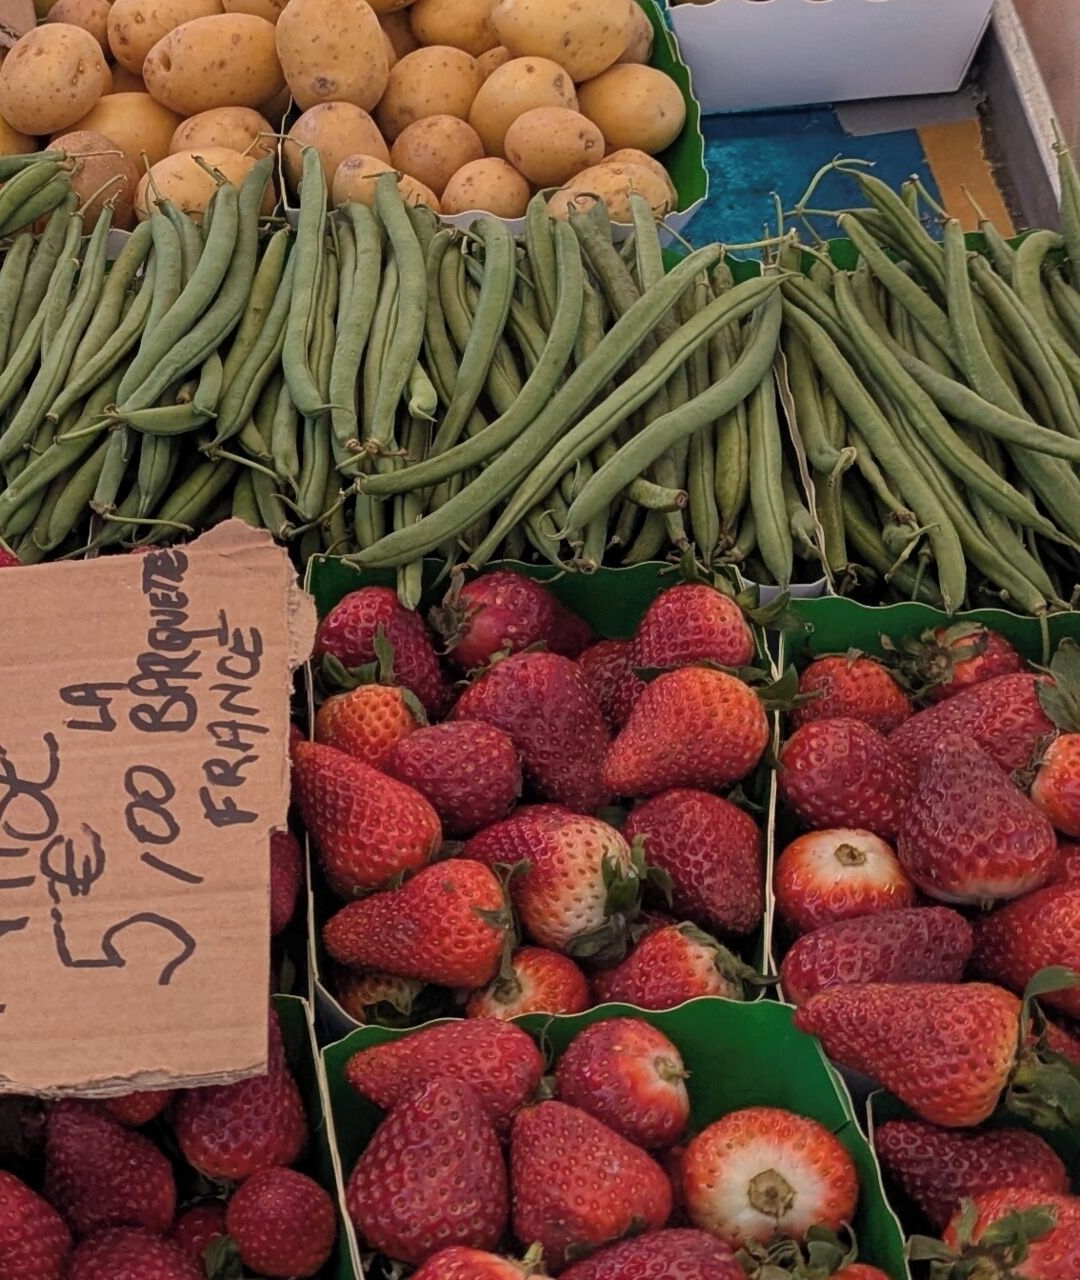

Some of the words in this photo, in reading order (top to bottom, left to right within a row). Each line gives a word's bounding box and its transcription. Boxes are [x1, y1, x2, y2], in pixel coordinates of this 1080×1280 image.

[60, 681, 128, 732] LA
[128, 548, 229, 733] BARQUETTE
[199, 625, 270, 827] FRANCE
